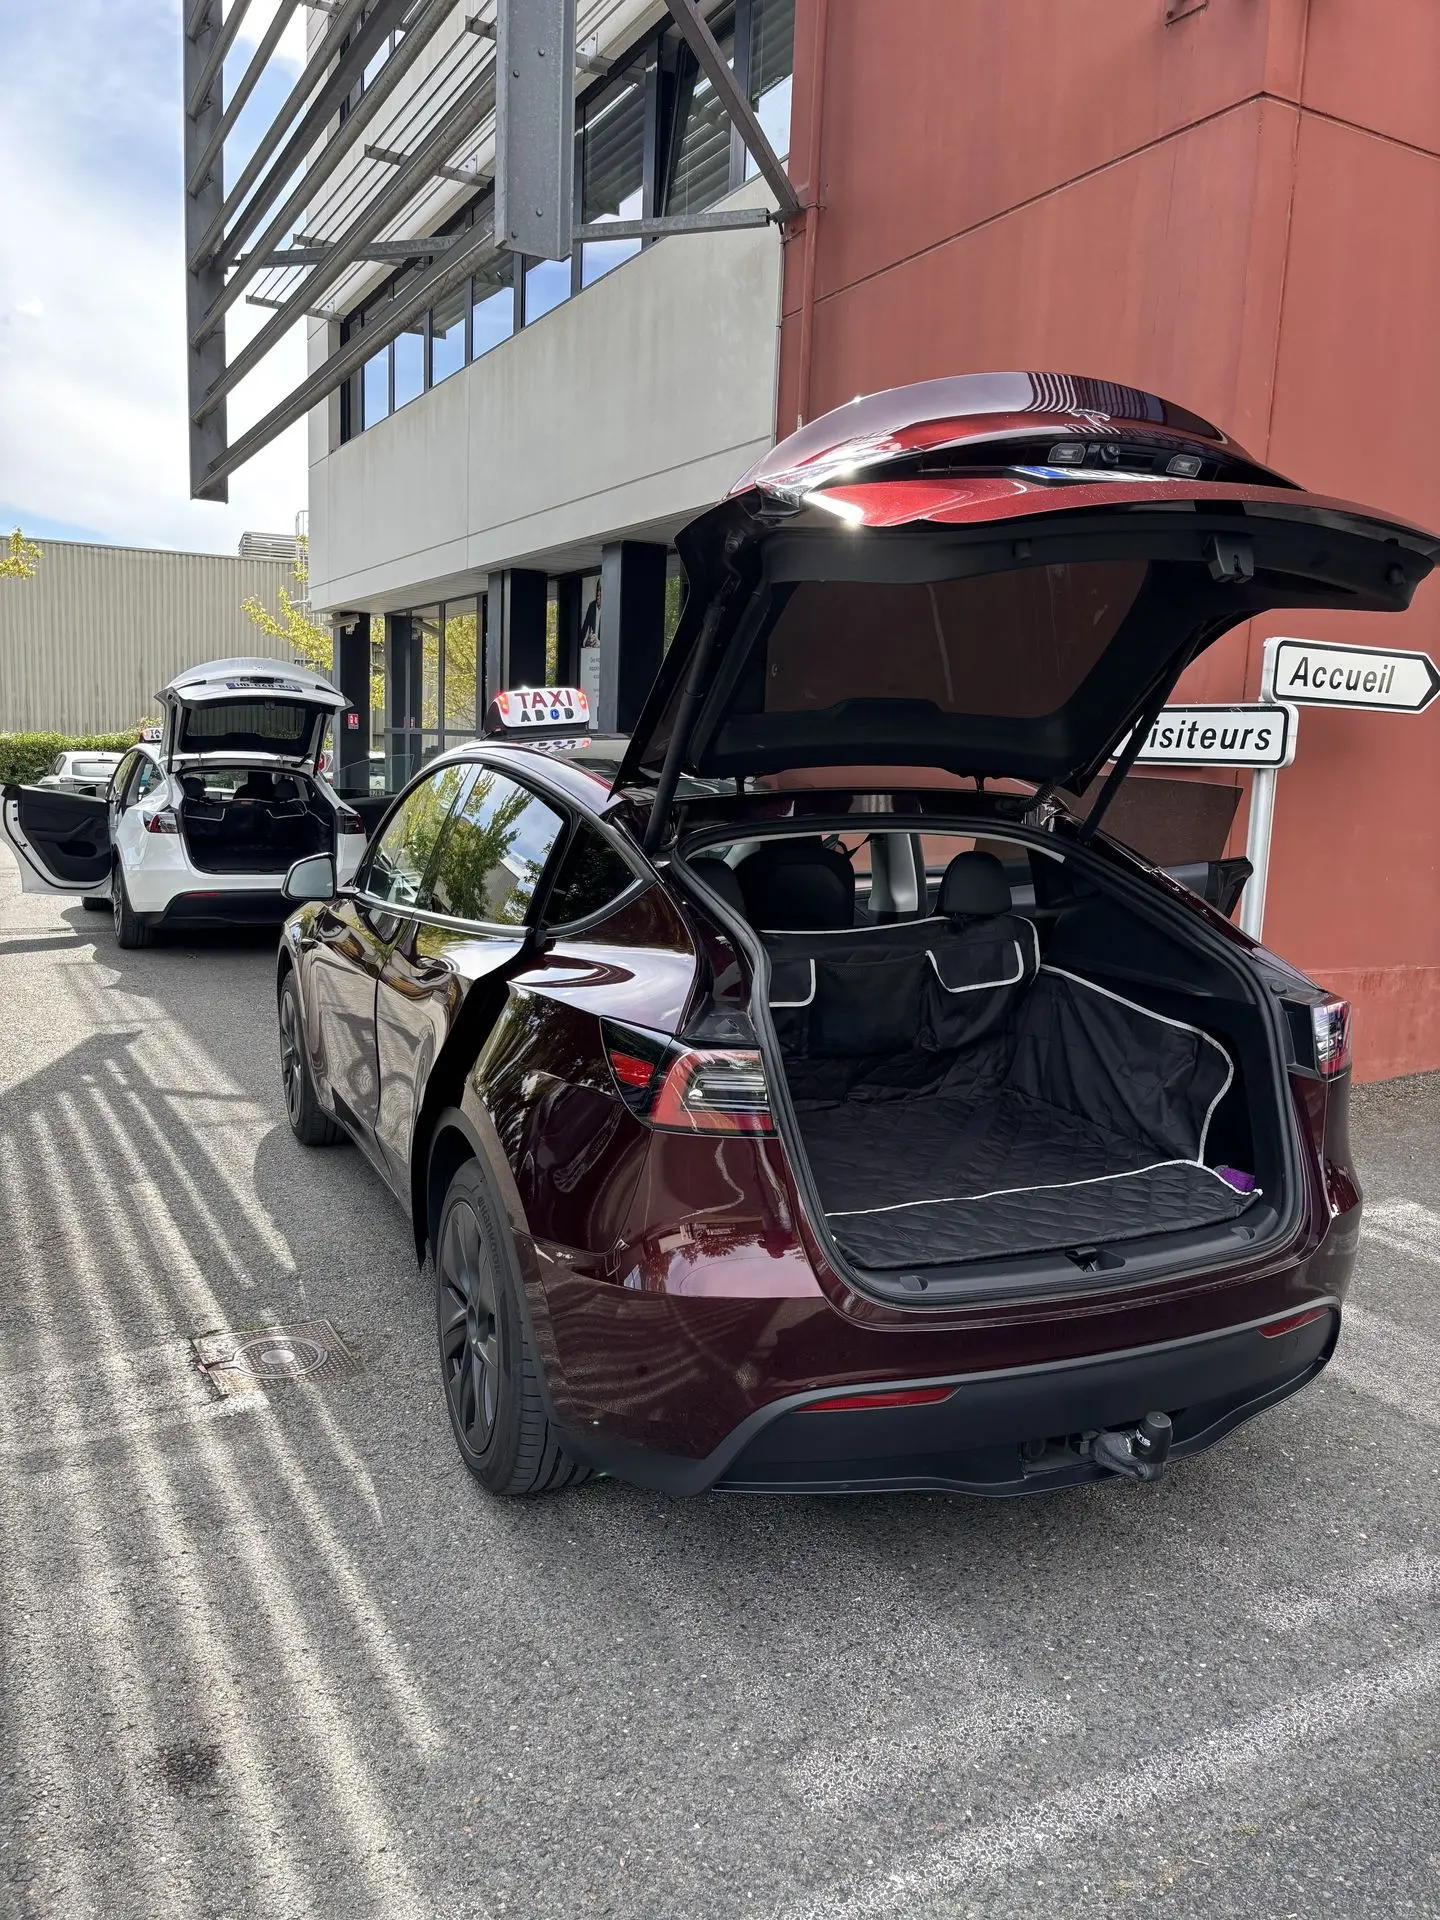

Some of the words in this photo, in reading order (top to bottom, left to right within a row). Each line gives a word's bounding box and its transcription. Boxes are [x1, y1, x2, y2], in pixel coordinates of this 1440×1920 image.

[1289, 656, 1395, 694] Accueil
[514, 690, 573, 709] TAXI
[1149, 720, 1272, 751] isiteurs
